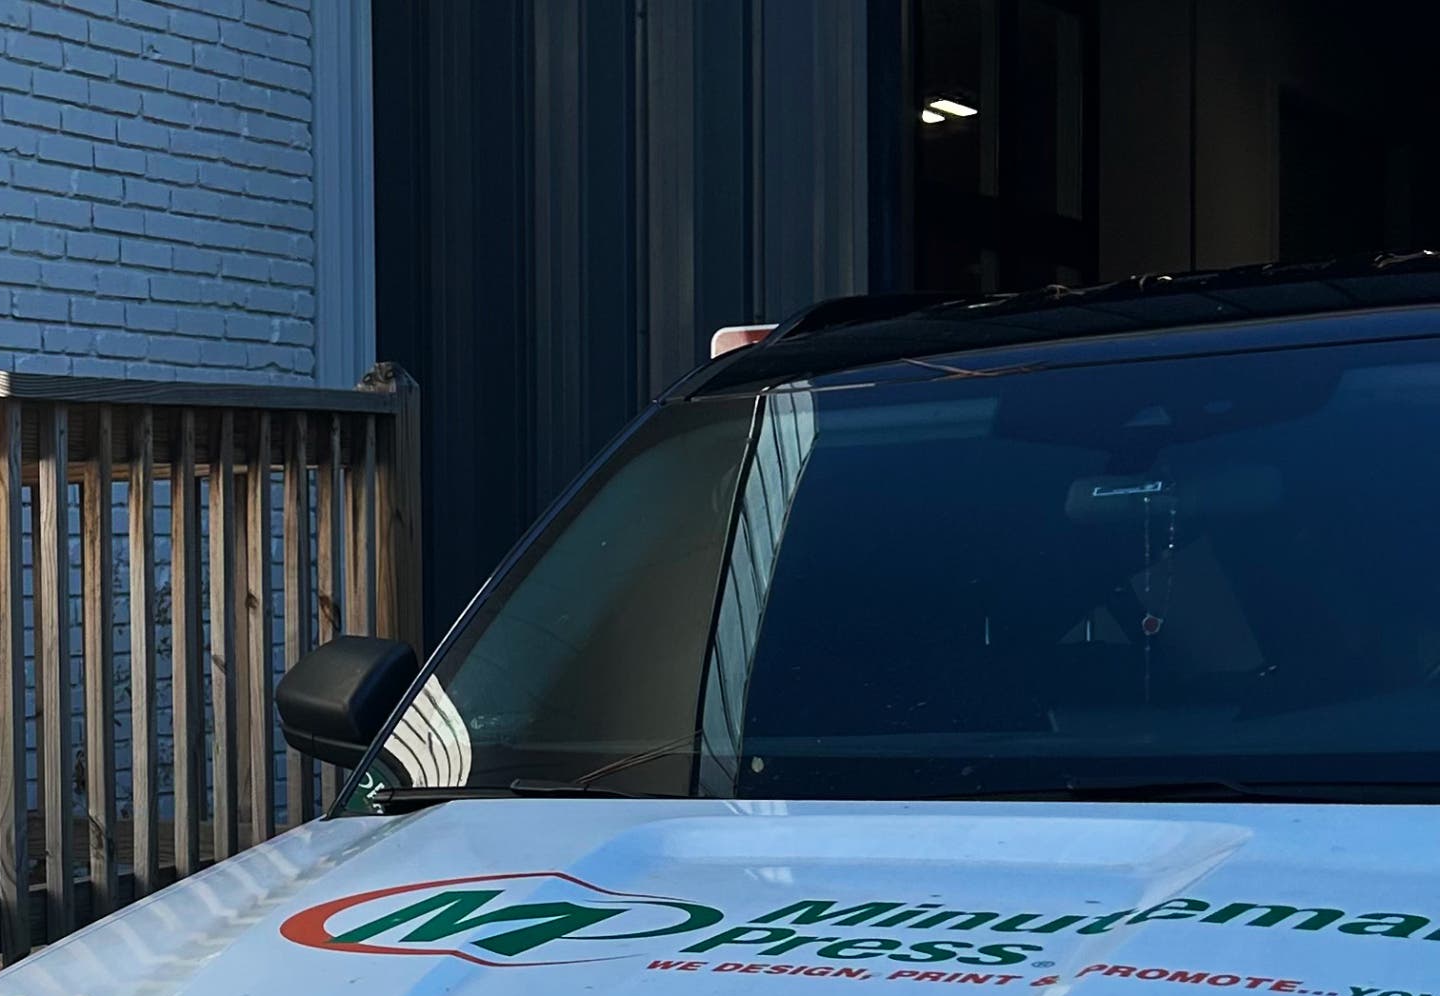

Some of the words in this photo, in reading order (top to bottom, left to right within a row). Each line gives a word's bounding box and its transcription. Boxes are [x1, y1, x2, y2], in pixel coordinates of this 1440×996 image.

[748, 898, 1440, 942] Minutema
[646, 959, 709, 972] WE
[711, 961, 873, 980] DESIGN,
[886, 969, 1024, 986] PRINT
